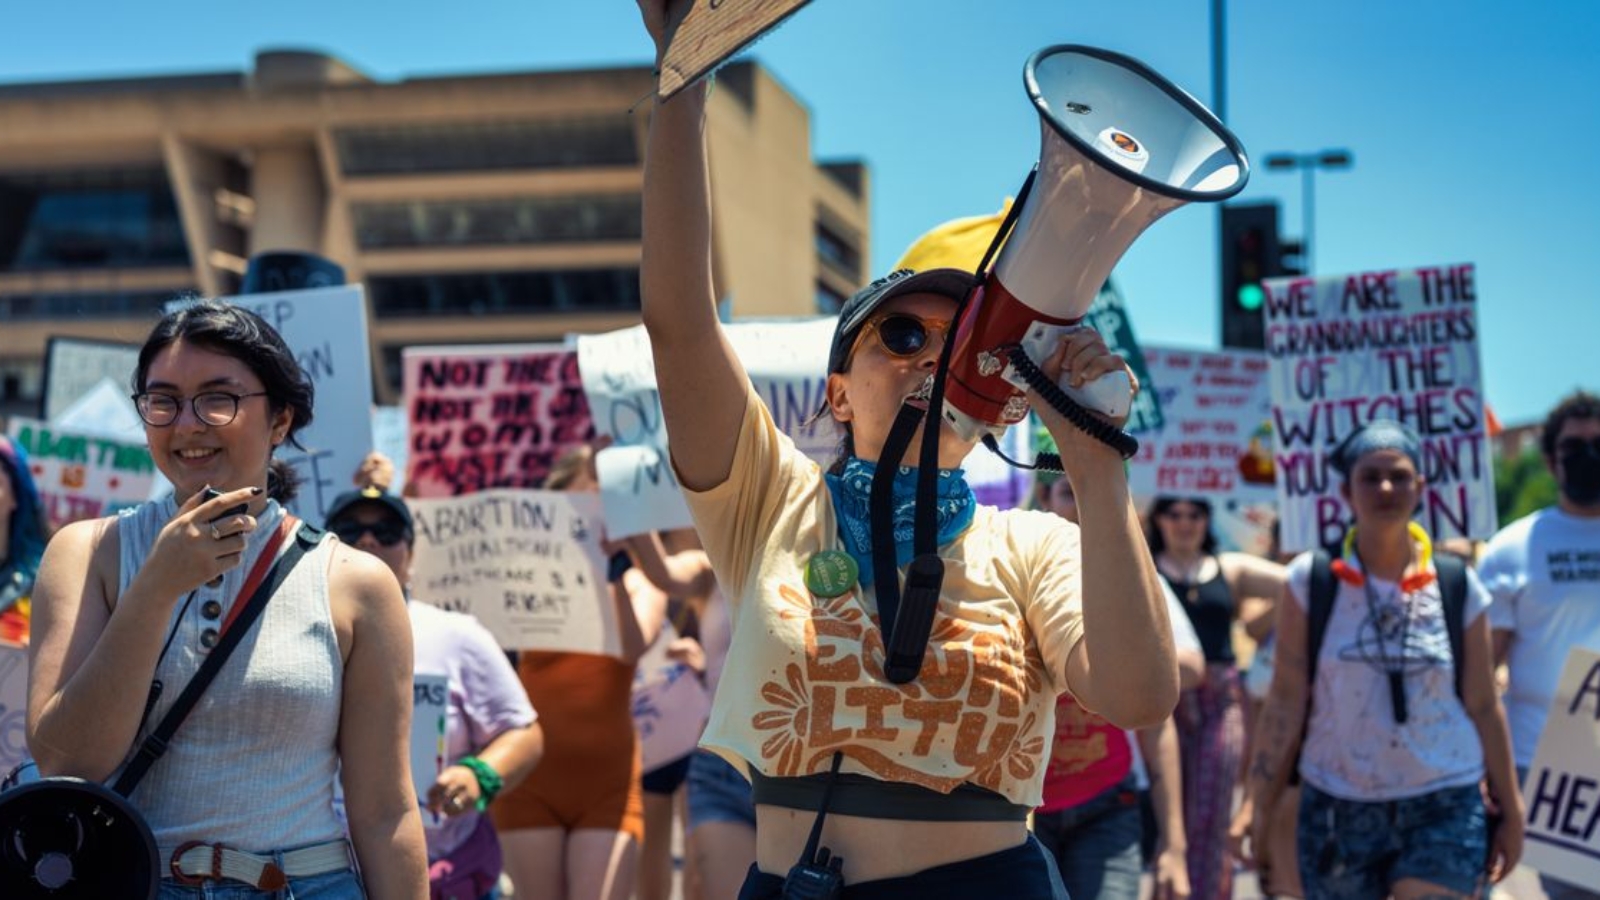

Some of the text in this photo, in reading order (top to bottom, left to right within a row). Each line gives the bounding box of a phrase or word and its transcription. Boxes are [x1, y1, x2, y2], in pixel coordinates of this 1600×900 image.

[1263, 264, 1476, 319] WE ARE THE
[1265, 308, 1476, 359] GRANDDAUGHTERS
[419, 359, 493, 389] NOT
[1295, 356, 1337, 400] OF
[1378, 346, 1455, 391] THE
[1272, 387, 1478, 448] WITCHES
[1276, 452, 1328, 498] YOU
[414, 497, 557, 545] ABORTION
[1316, 484, 1469, 556] BN
